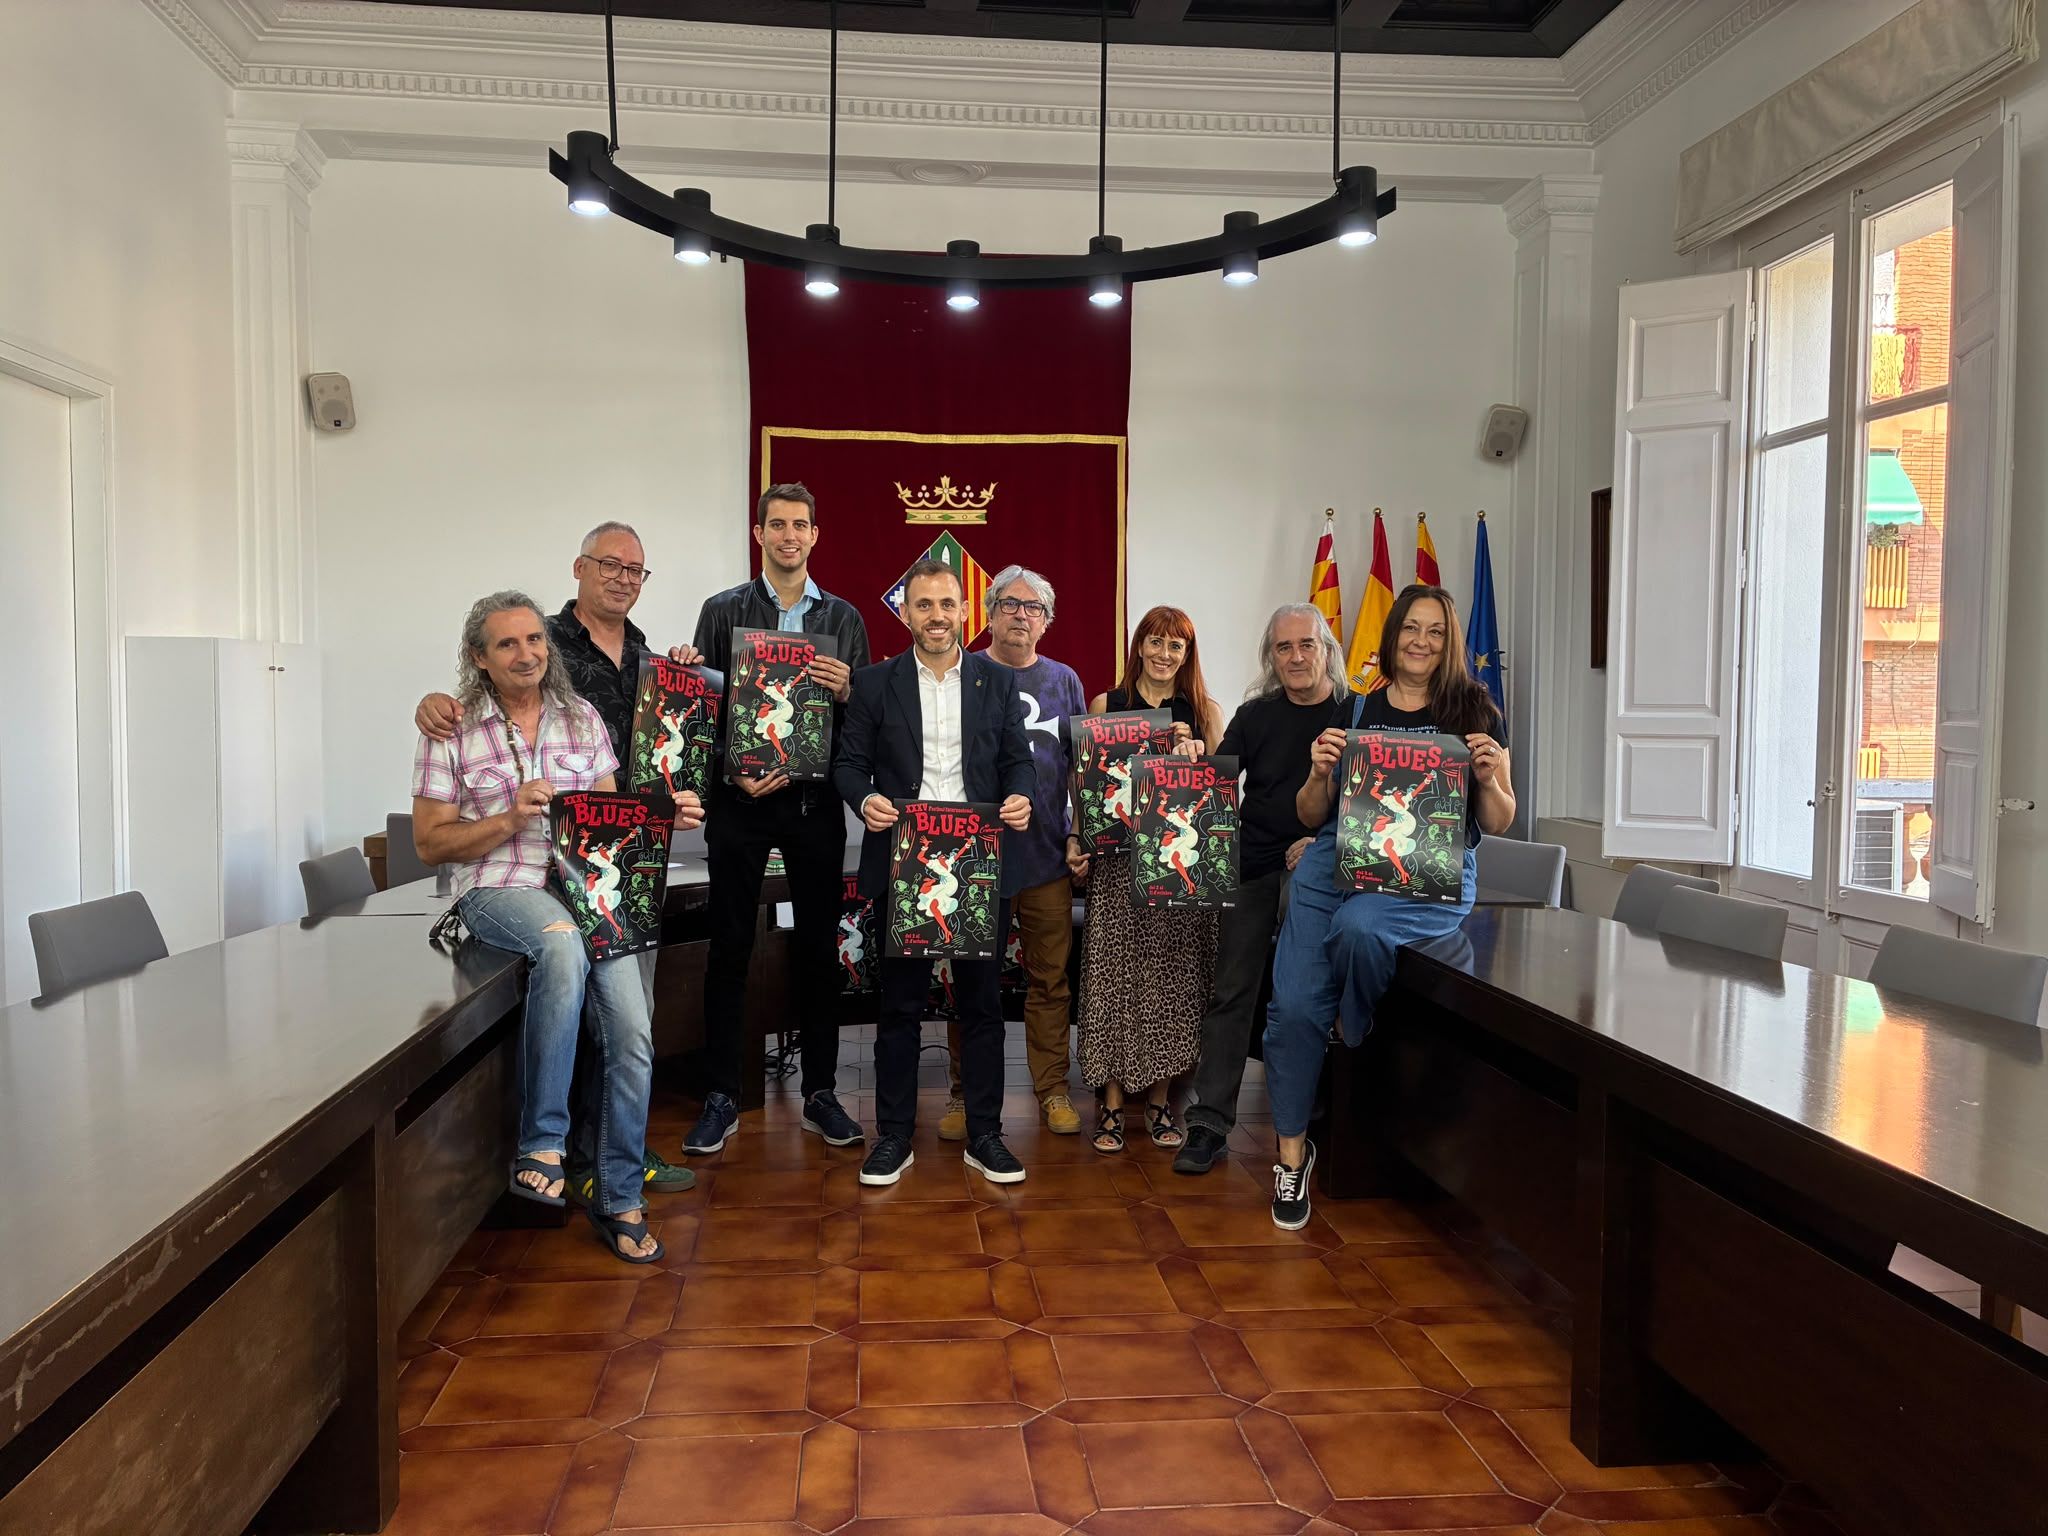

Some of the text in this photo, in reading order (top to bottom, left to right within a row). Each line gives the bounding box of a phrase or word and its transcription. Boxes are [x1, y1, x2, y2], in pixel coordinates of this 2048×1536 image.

[744, 632, 766, 641] XXXV
[648, 657, 667, 666] XXXV
[753, 640, 816, 666] BLUES
[656, 666, 705, 698] BLUES
[1081, 716, 1101, 728] XXXV
[1090, 721, 1151, 744] BLUES
[1358, 734, 1383, 744] XXXV
[1143, 758, 1164, 768] XXXV
[1369, 742, 1442, 771] BLUES
[1153, 766, 1216, 790] BLUES
[563, 793, 588, 805] XXXV
[574, 802, 648, 827] BLUES
[905, 803, 928, 814] XXXV
[915, 812, 980, 837] BLUES
